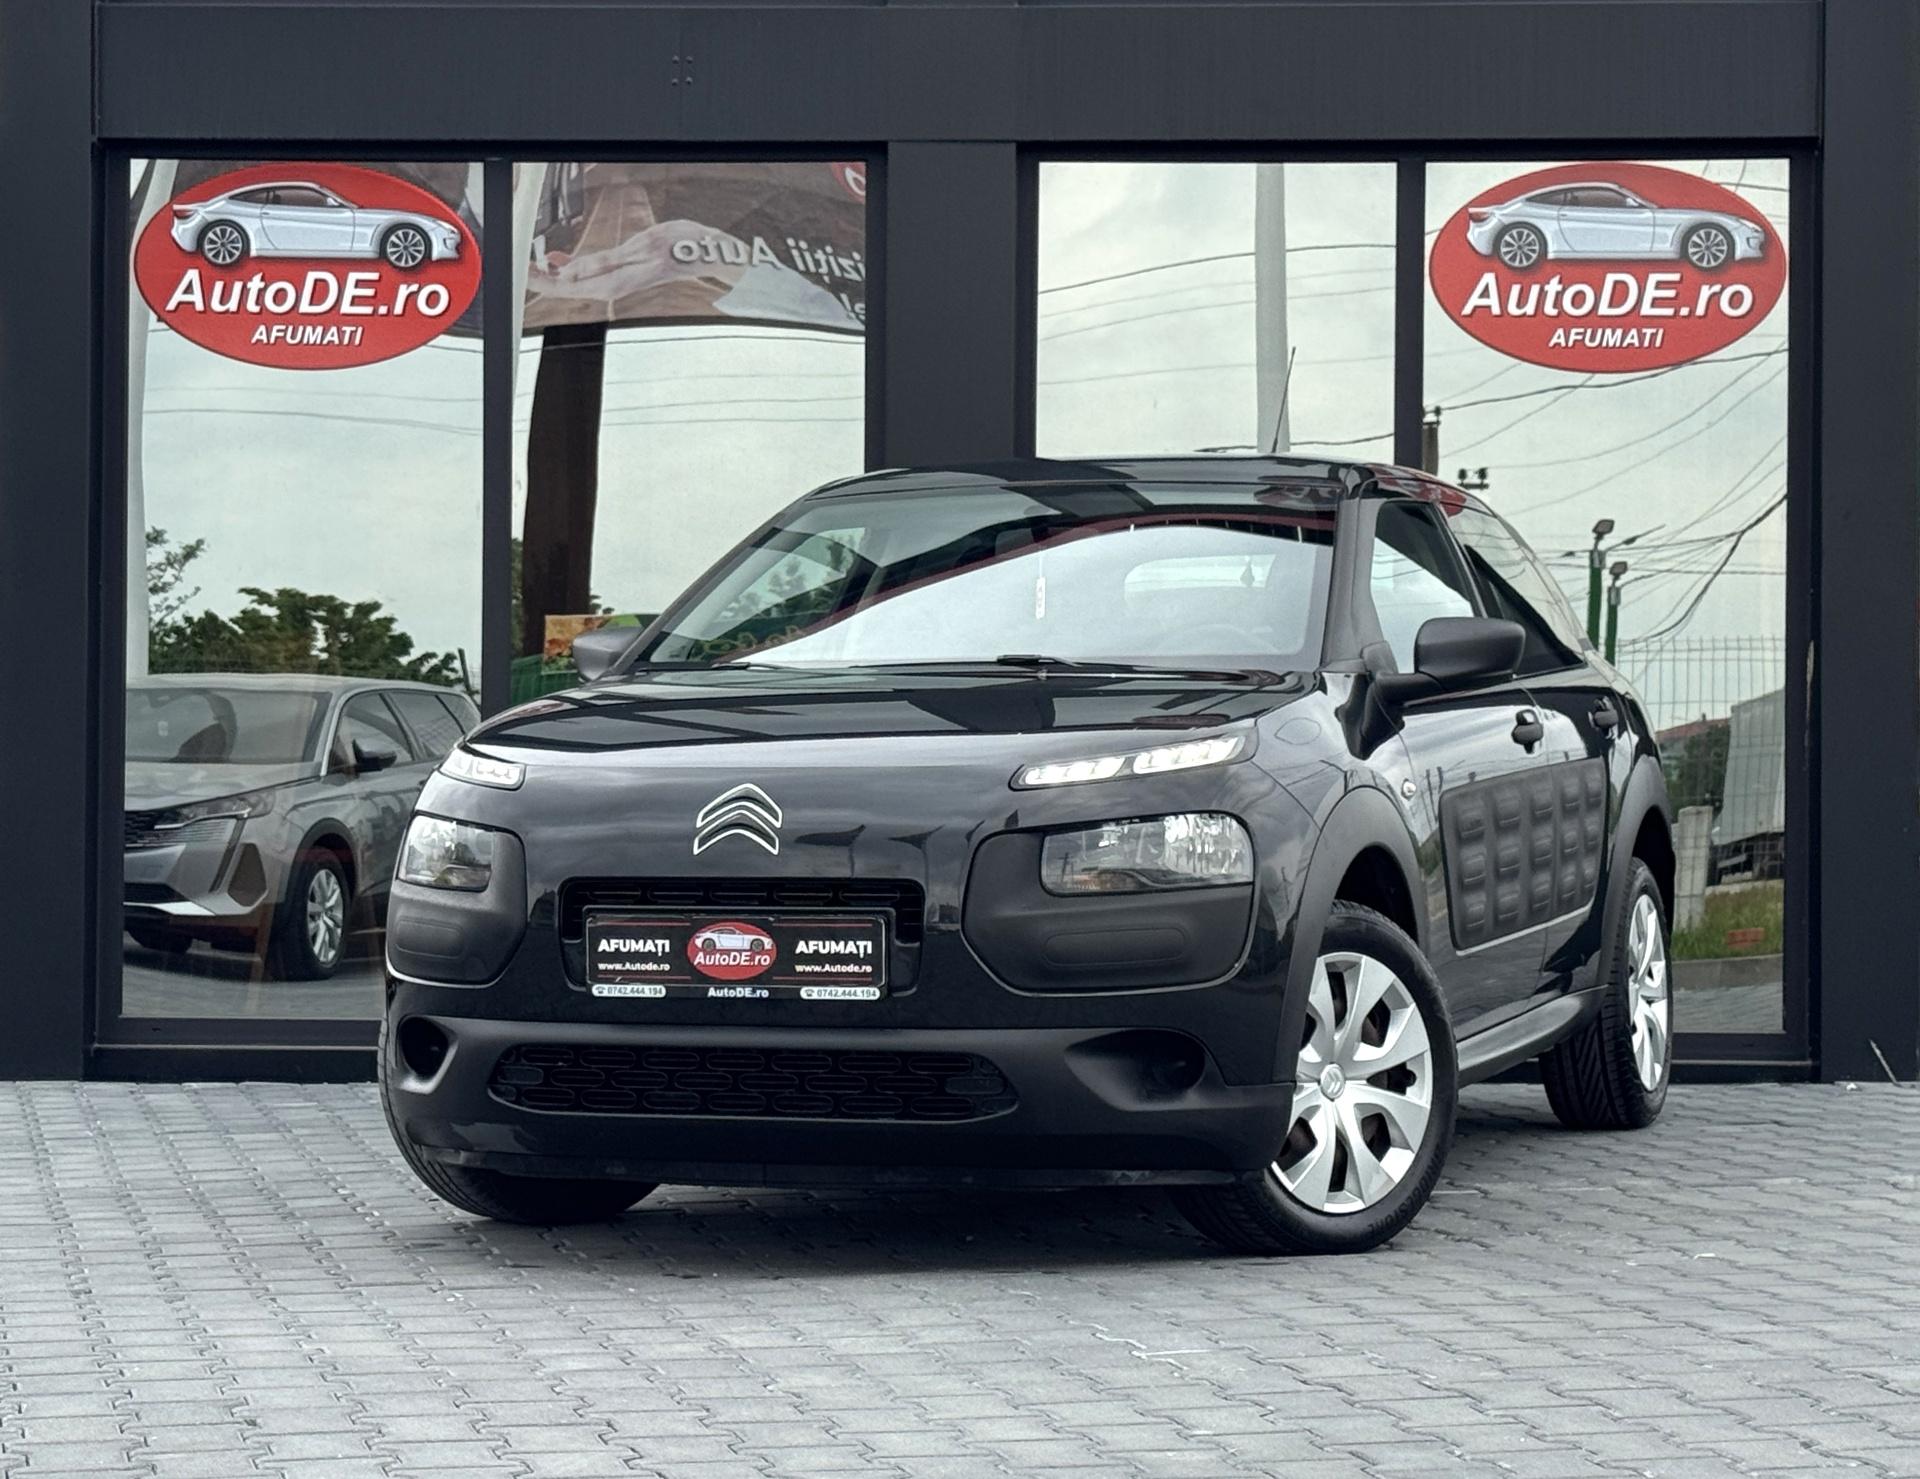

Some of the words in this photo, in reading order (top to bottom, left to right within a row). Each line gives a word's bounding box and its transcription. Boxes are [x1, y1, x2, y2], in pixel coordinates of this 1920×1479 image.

[165, 269, 450, 317] AutoDE.ro
[1461, 272, 1754, 318] AutoDE.ro
[251, 324, 364, 347] AFUMATI
[1548, 327, 1664, 348] AFUMATI
[694, 951, 770, 967] AutoDE.ro
[794, 963, 873, 973] www.Autode.ro
[707, 987, 769, 998] AutoDE.ro
[817, 989, 877, 998] 0742.444.194
